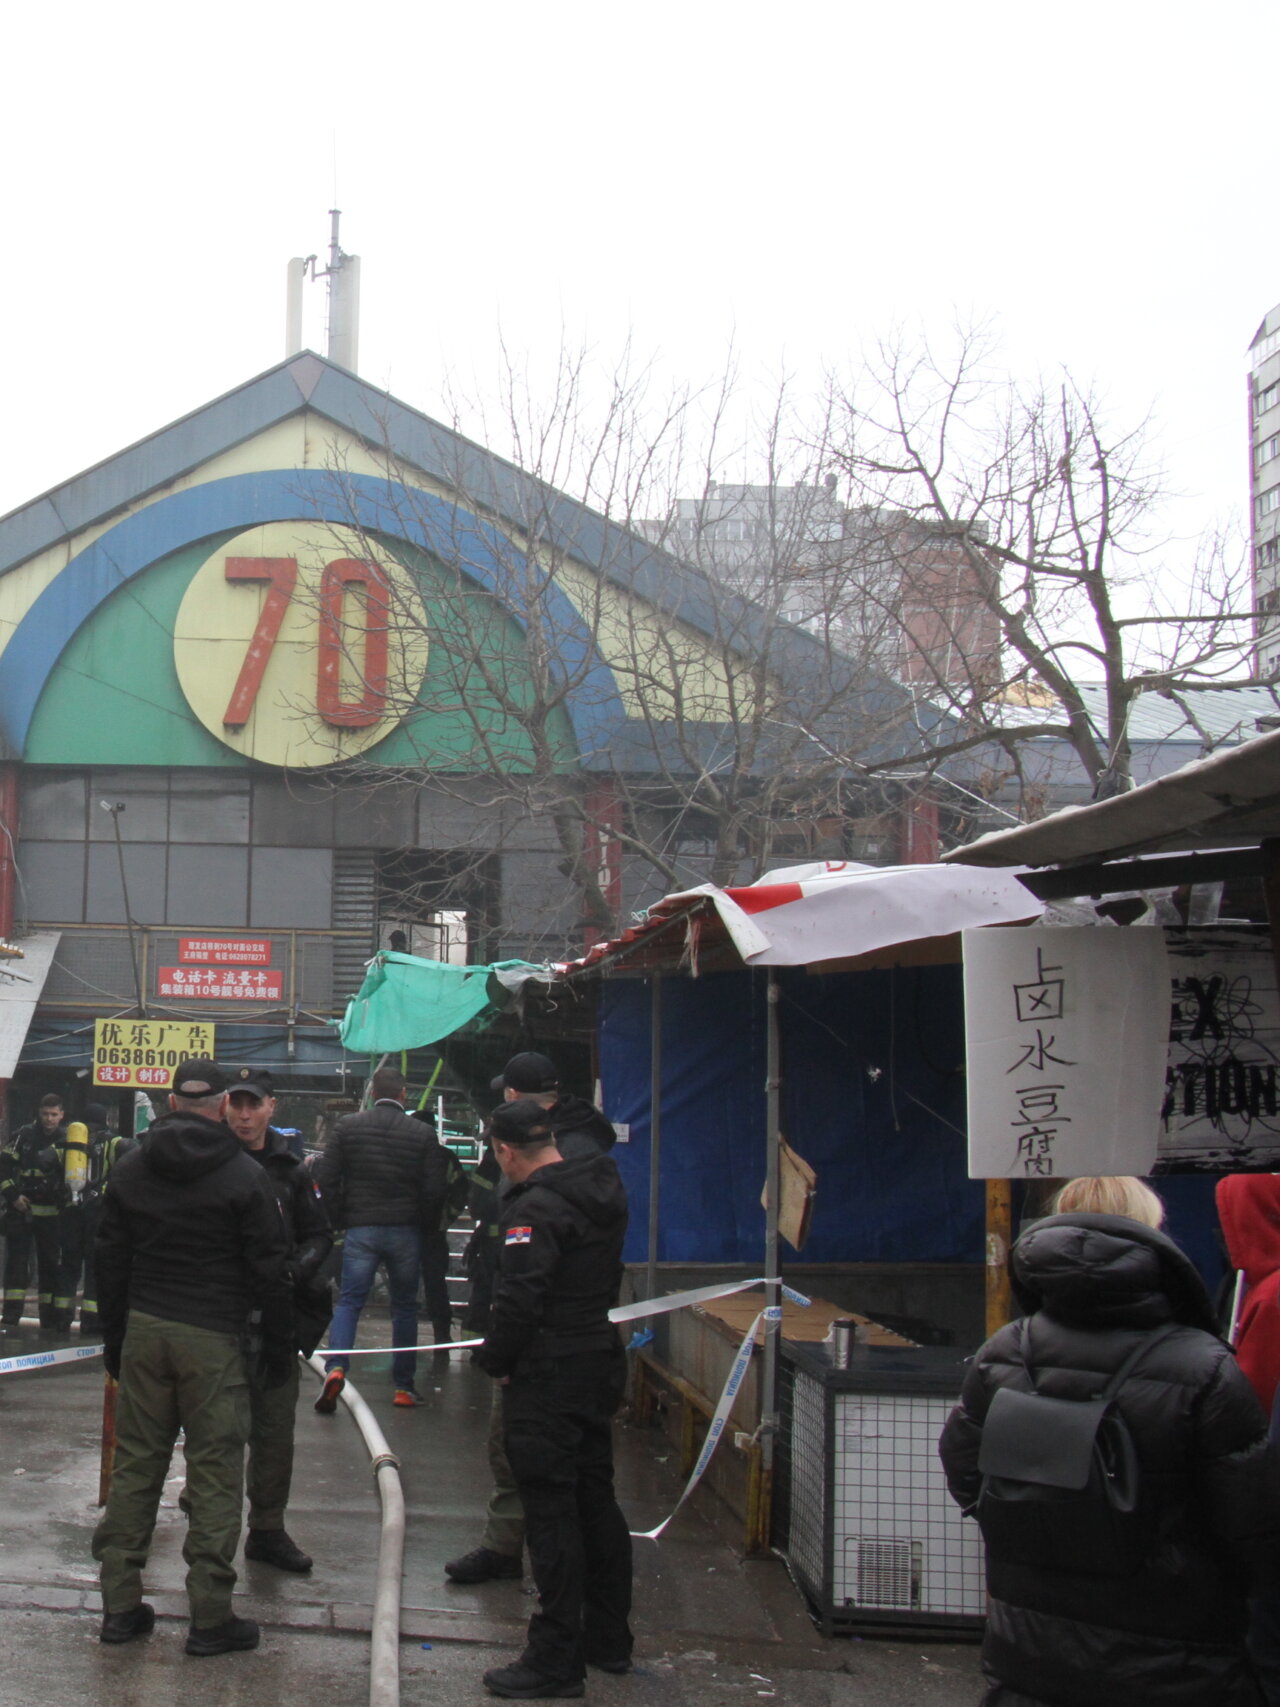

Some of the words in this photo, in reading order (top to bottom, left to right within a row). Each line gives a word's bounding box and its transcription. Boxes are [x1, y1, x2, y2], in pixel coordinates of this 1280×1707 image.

[223, 556, 389, 727] 70
[172, 969, 217, 985] 电话卡
[222, 971, 268, 986] 流量卡
[100, 1023, 209, 1050] 优乐广告
[1006, 946, 1078, 1177] 卤水豆腐
[100, 1067, 129, 1081] 设计
[139, 1069, 168, 1083] 制作
[16, 1353, 56, 1368] ПОЛИЦИЈА
